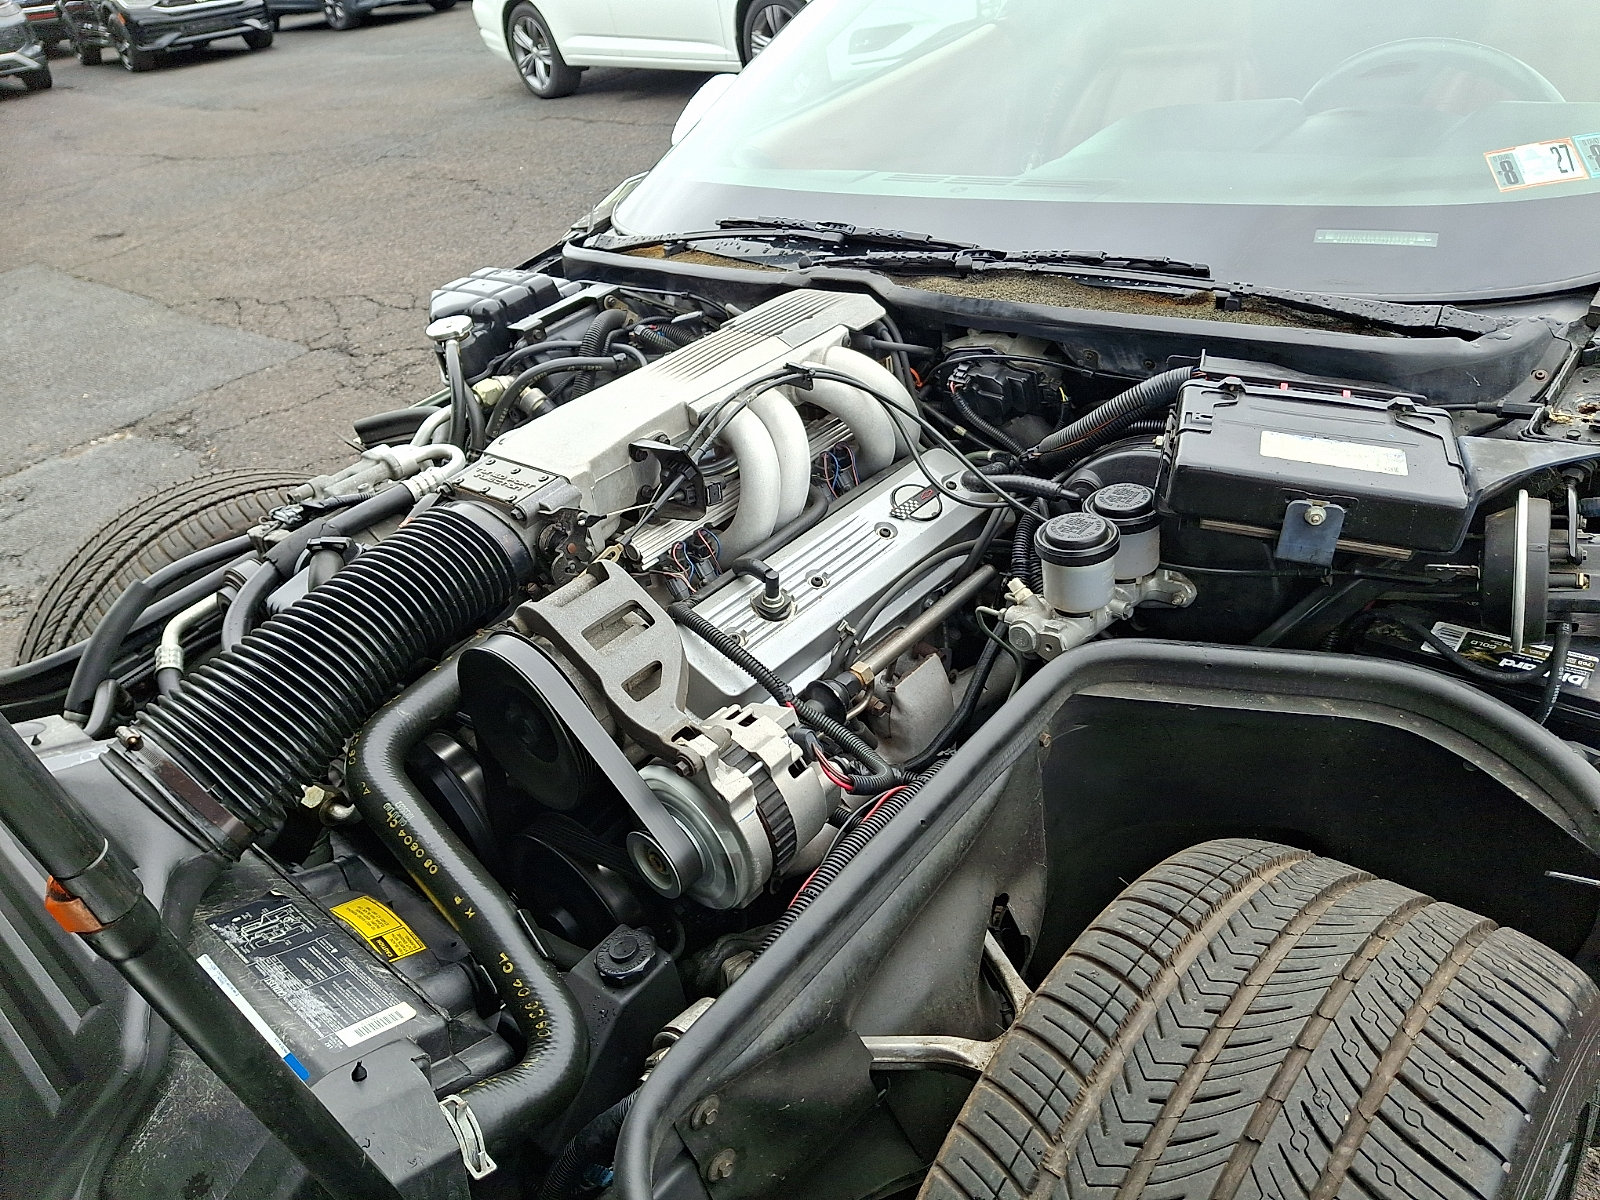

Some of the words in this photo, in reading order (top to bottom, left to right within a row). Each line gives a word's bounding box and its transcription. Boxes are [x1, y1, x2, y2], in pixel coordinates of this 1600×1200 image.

[1549, 144, 1575, 173] 27
[1499, 160, 1519, 185] 8
[1470, 639, 1497, 650] GOLD
[375, 939, 394, 957] CAUTION
